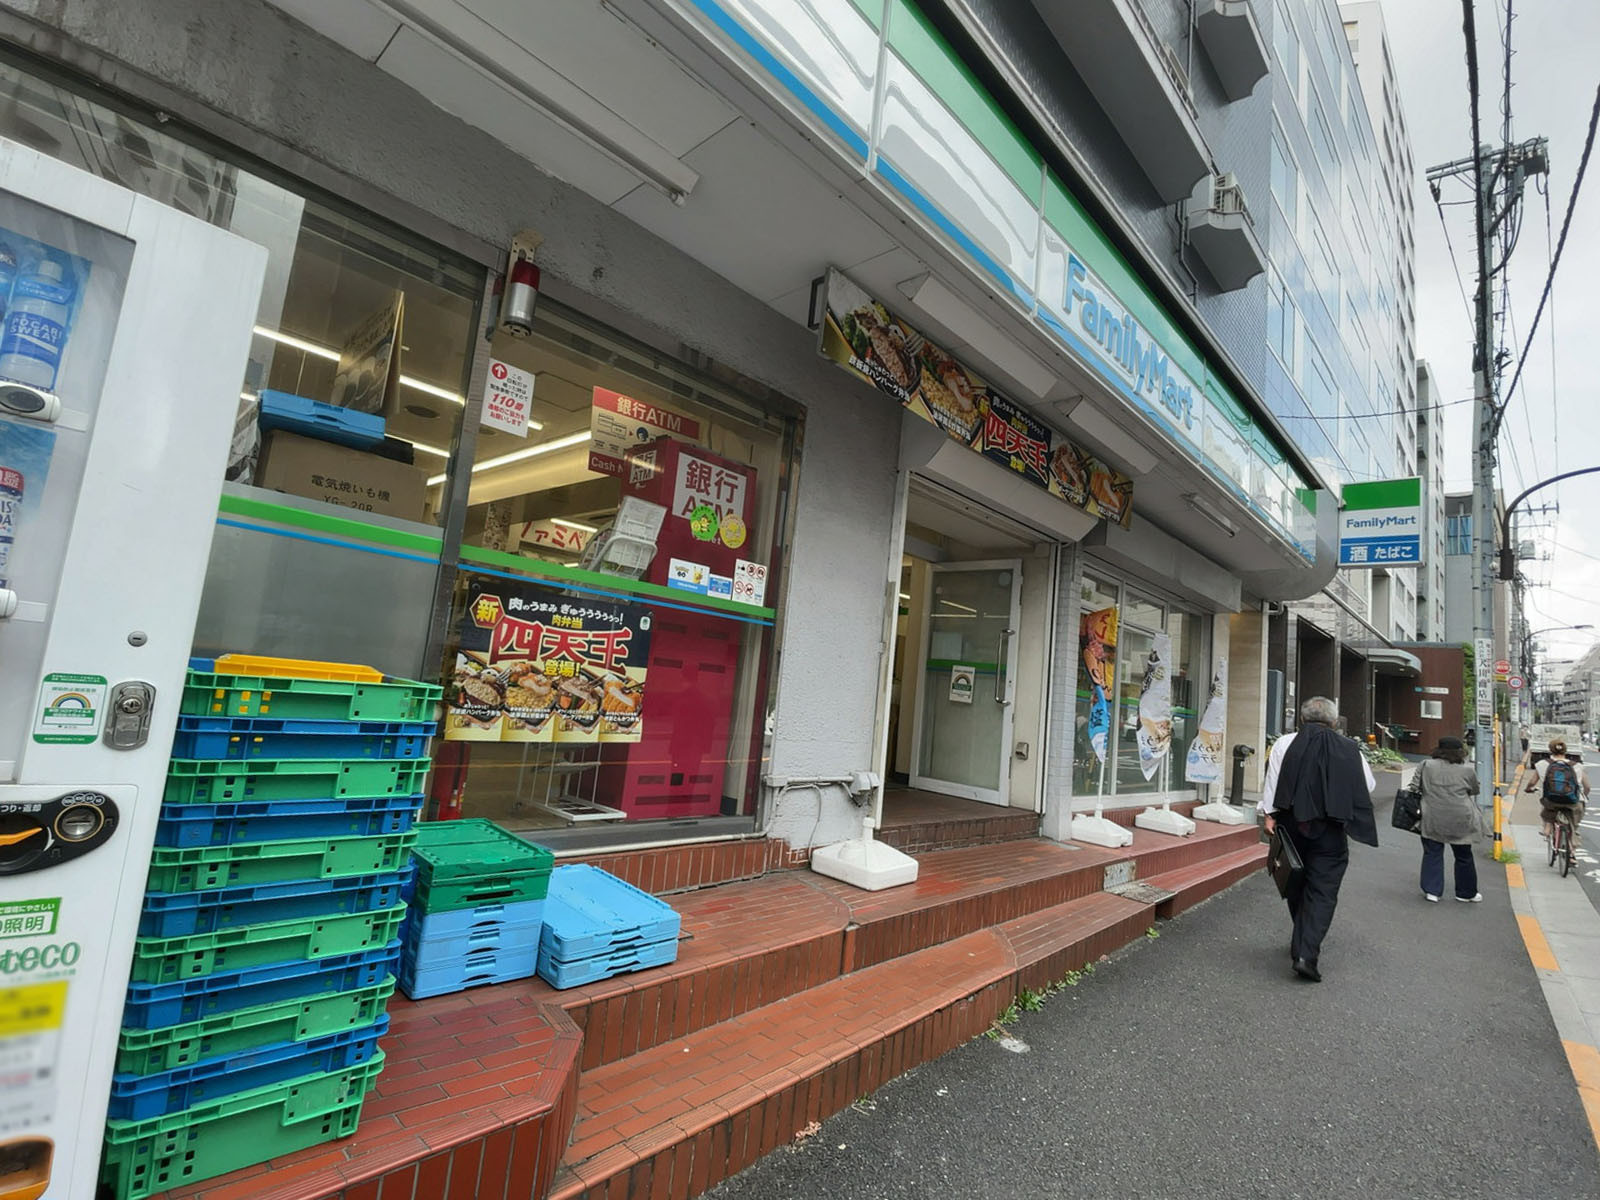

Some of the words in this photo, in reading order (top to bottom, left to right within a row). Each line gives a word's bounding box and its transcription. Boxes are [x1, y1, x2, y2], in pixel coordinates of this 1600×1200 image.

[10, 326, 58, 343] SWEAT
[12, 318, 62, 339] POCARI
[1063, 252, 1194, 430] FamilyMart
[493, 393, 524, 411] 110番
[617, 396, 681, 432] 銀行ATM
[985, 410, 1048, 484] 四天王
[591, 456, 615, 473] Cash
[311, 474, 391, 502] 電気焼いも機
[685, 459, 738, 503] 銀行
[1346, 515, 1417, 529] FamilyMart
[1349, 545, 1369, 562] 酒
[1374, 545, 1413, 559] たばこ
[476, 599, 499, 624] 新
[508, 598, 558, 614] 肉のうまみ
[551, 614, 583, 629] 肉弁当
[487, 616, 632, 676] 四天王
